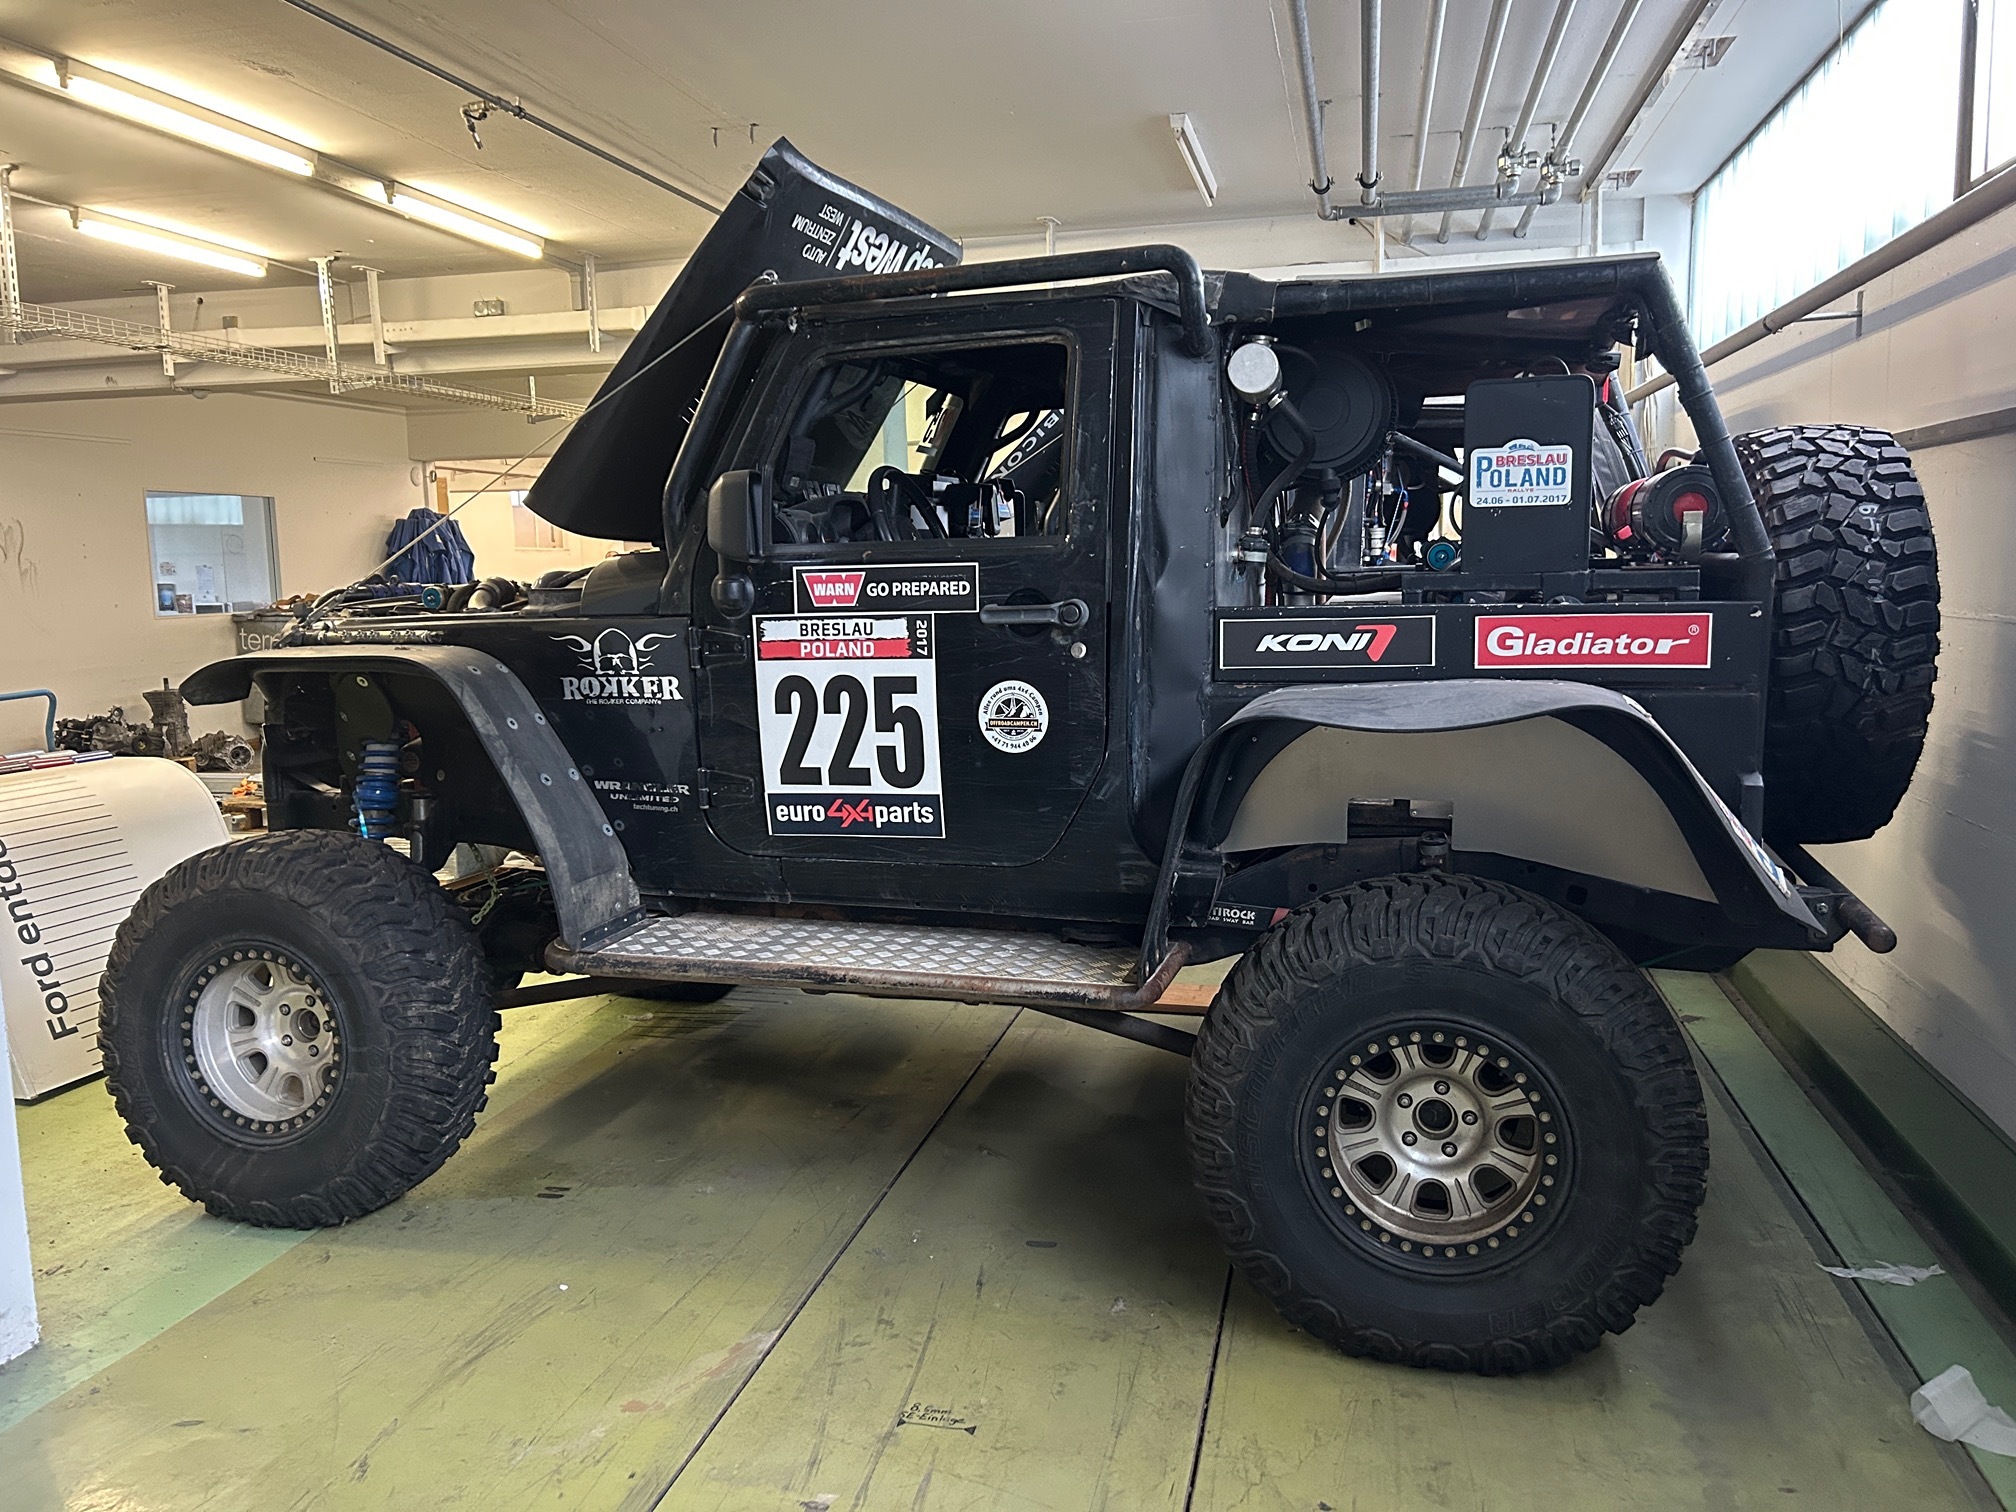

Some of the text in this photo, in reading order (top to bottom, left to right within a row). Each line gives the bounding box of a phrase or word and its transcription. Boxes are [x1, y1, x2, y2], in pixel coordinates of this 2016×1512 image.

[818, 203, 844, 227] WEST
[791, 213, 837, 246] ZENTRUM
[802, 243, 827, 264] AUTO
[1476, 456, 1567, 489] POLAND
[1496, 453, 1568, 468] BRESLAU
[1476, 496, 1503, 505] 24.06
[1512, 494, 1567, 504] 01.07.2017
[813, 581, 971, 597] WARN GO PREPARED
[800, 621, 874, 637] BRESLAU
[916, 619, 928, 656] 2017
[800, 641, 875, 658] POLAND
[560, 675, 684, 700] ROKKER
[774, 674, 926, 789] 225
[775, 798, 934, 828] euro4x4parts
[21, 952, 79, 1041] Ford
